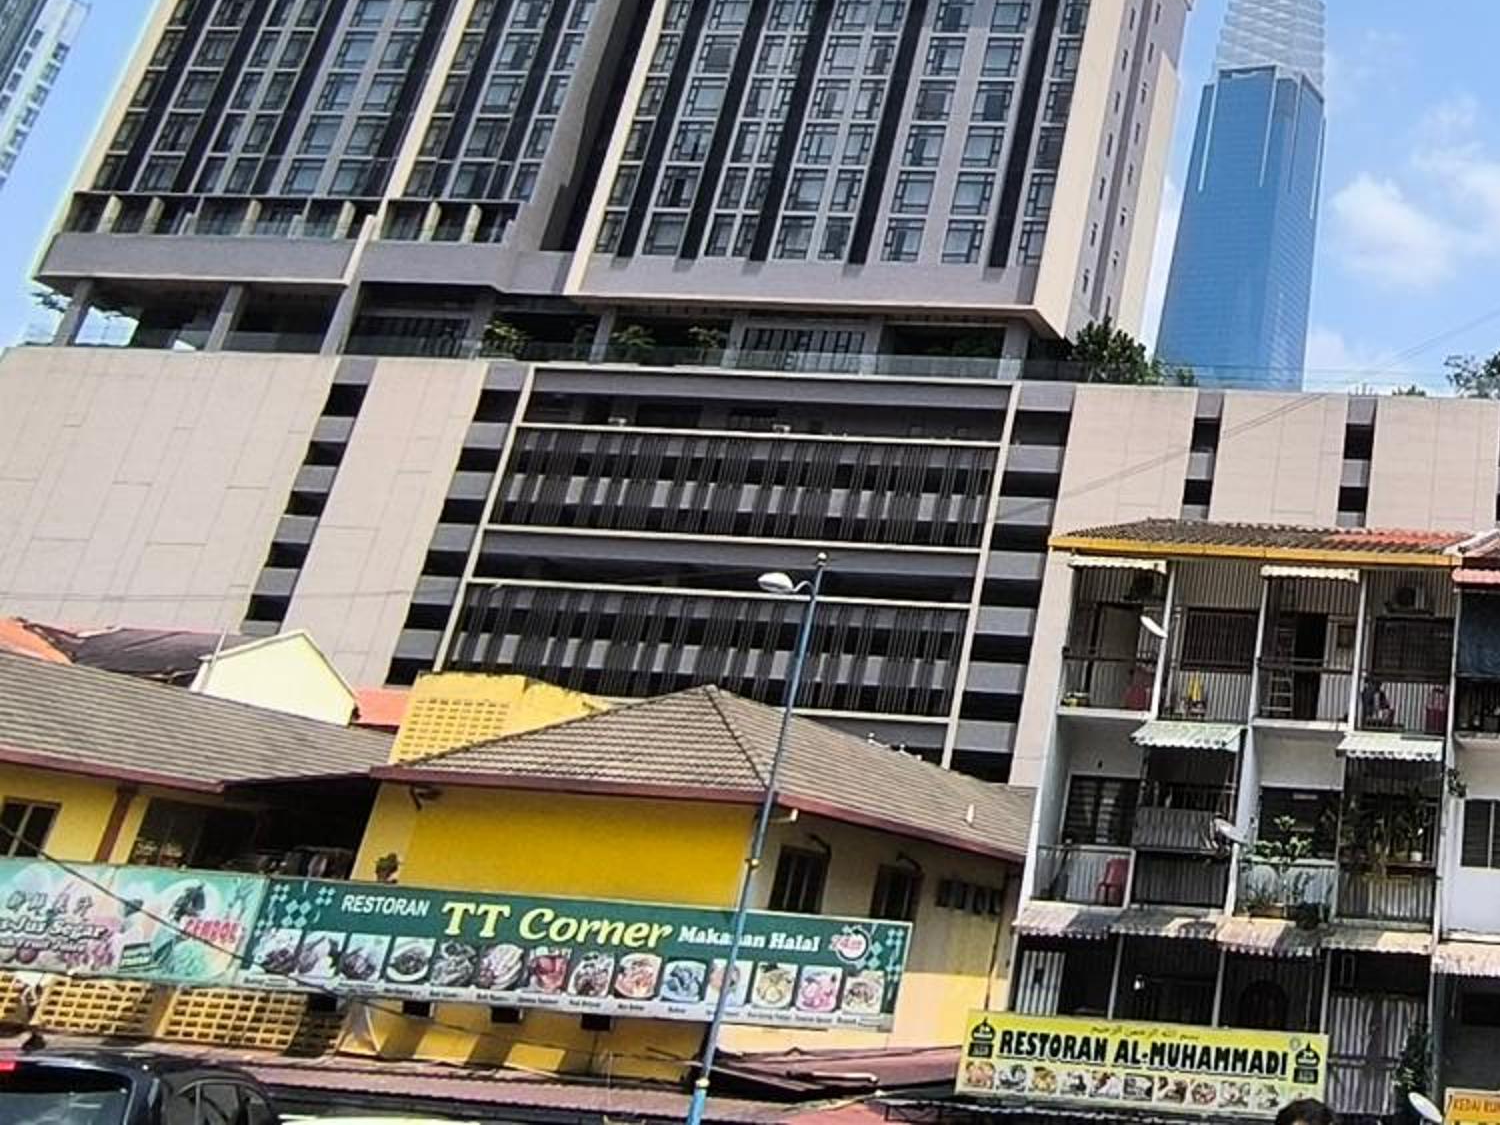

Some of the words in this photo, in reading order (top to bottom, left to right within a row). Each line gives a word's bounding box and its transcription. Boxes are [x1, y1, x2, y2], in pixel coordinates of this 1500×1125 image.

[341, 894, 430, 918] RESTORAN
[442, 901, 510, 938] TT
[519, 908, 673, 947] Corner
[768, 932, 821, 952] Halal
[999, 1030, 1108, 1063] RESTORAN
[1114, 1039, 1288, 1075] AL-MUHAMMADI
